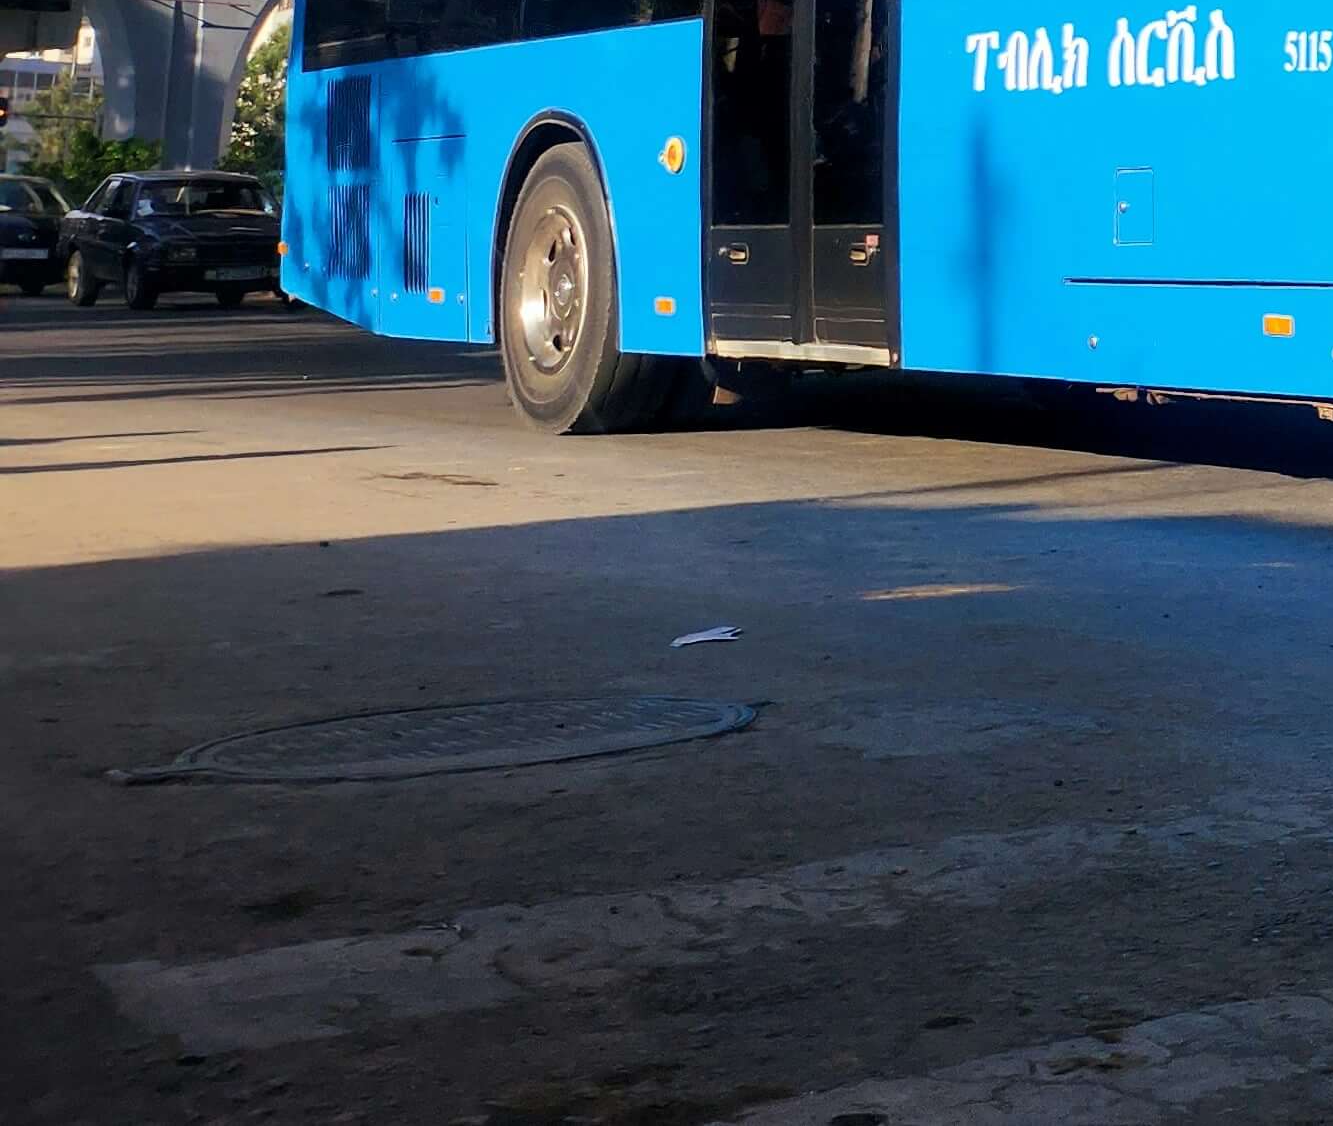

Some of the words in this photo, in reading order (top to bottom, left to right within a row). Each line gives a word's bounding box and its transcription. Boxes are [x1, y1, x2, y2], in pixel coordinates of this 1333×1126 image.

[965, 22, 1089, 95] ፐብሊክ
[1107, 4, 1236, 87] ሰርቪስ
[1284, 30, 1333, 72] 5115
